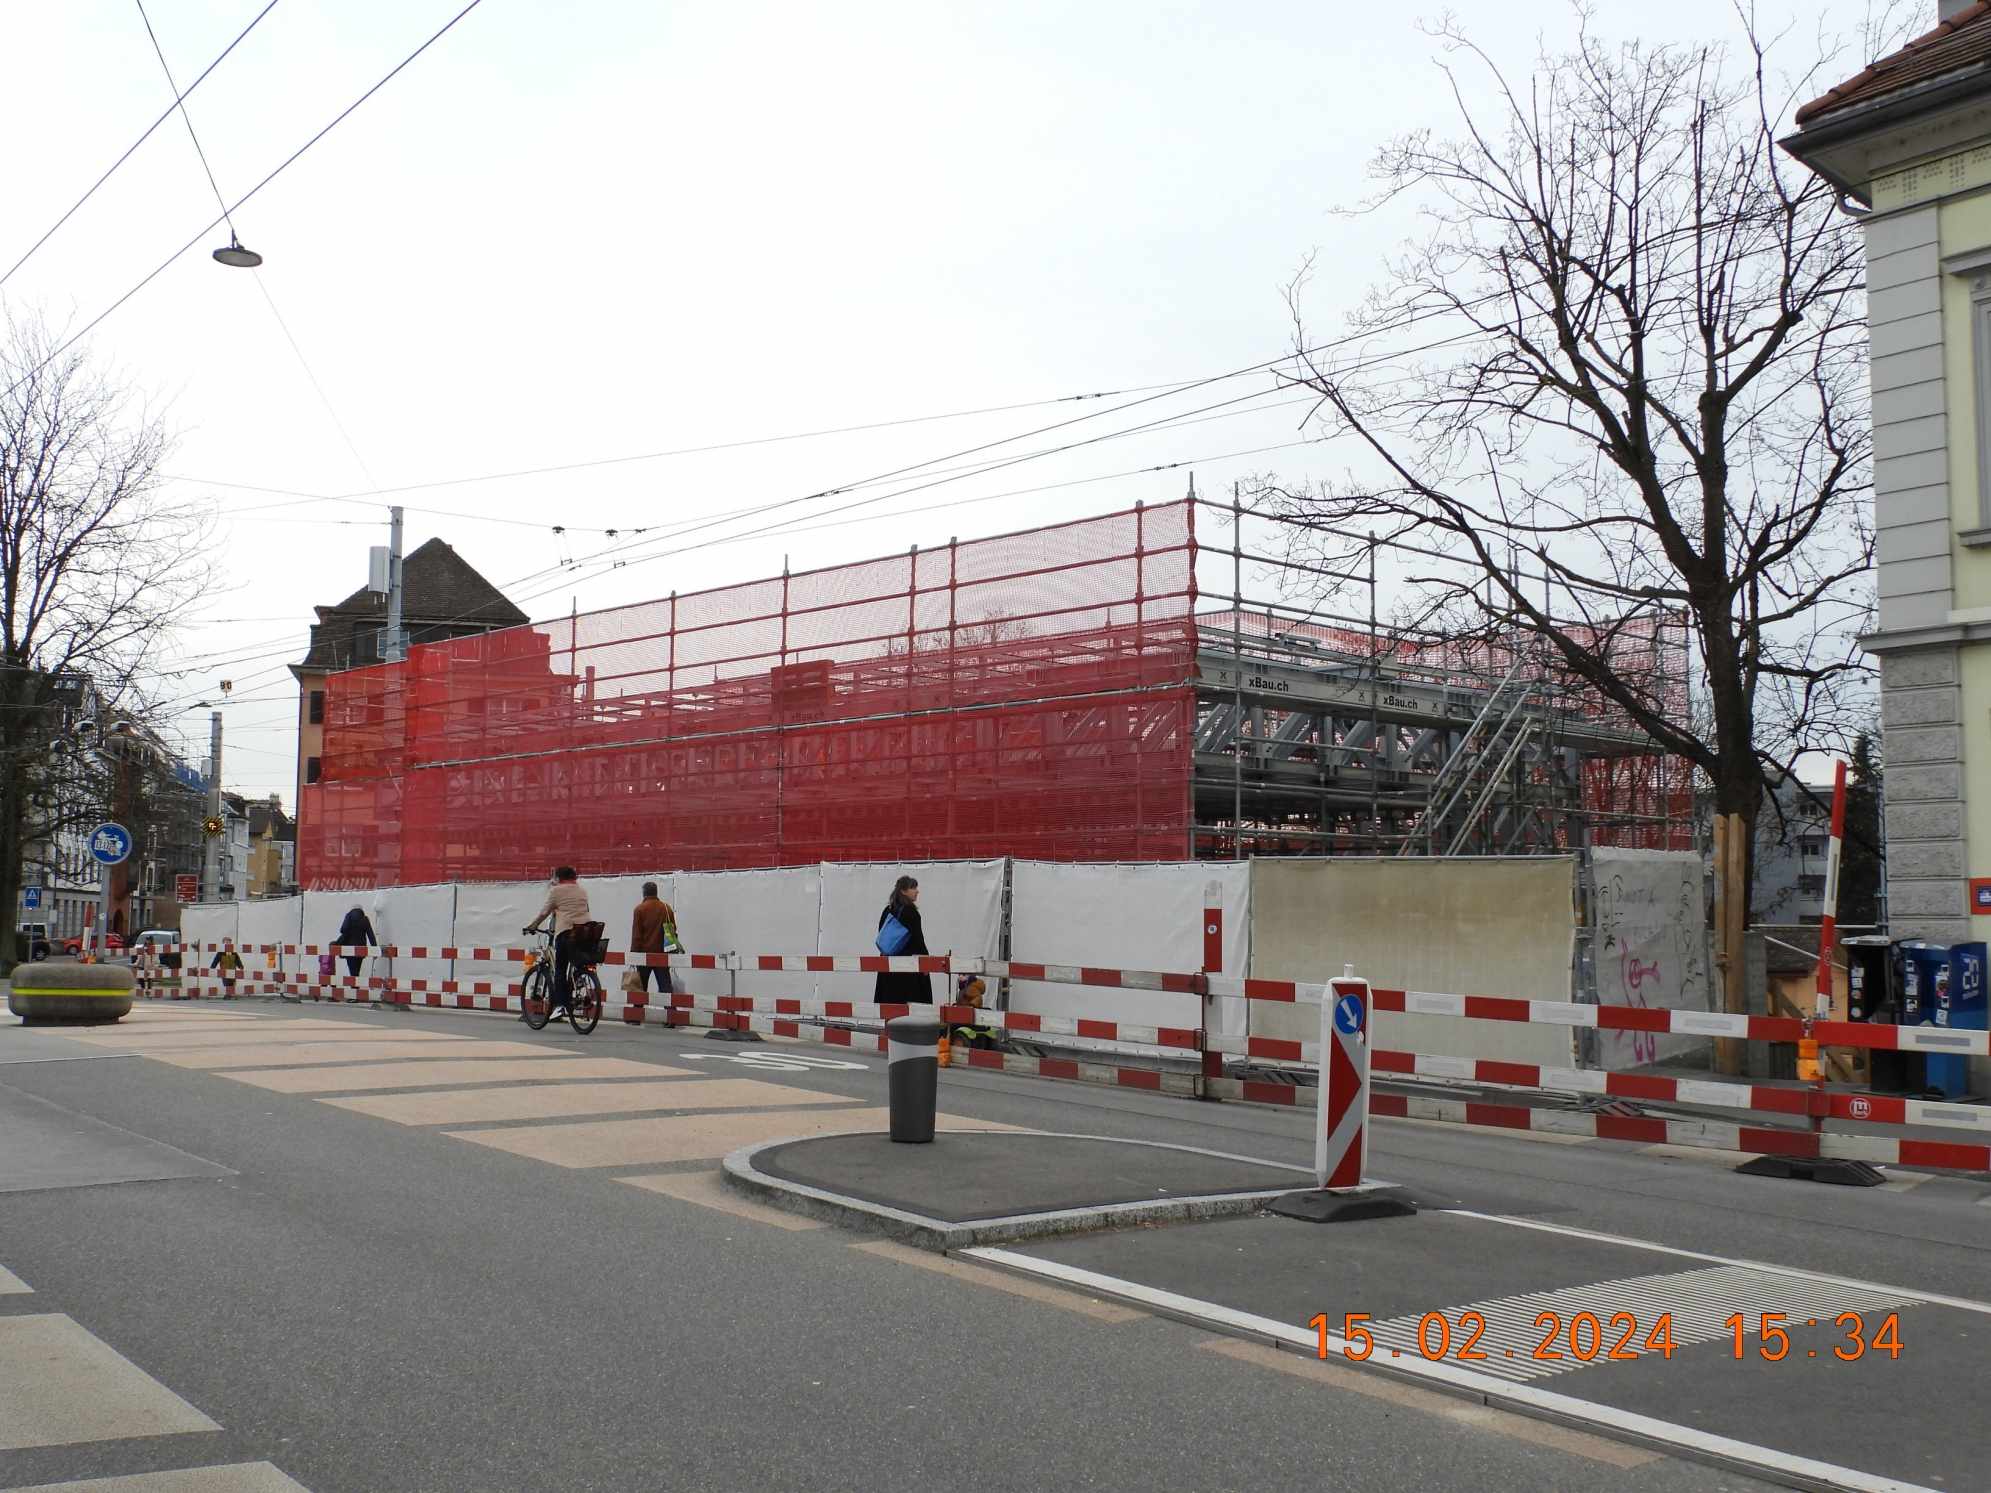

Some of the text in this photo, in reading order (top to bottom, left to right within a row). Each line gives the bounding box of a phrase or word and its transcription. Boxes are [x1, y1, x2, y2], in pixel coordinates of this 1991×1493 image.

[1249, 677, 1289, 692] xBau.ch
[1383, 695, 1418, 710] xBau.ch
[679, 1051, 869, 1071] 30
